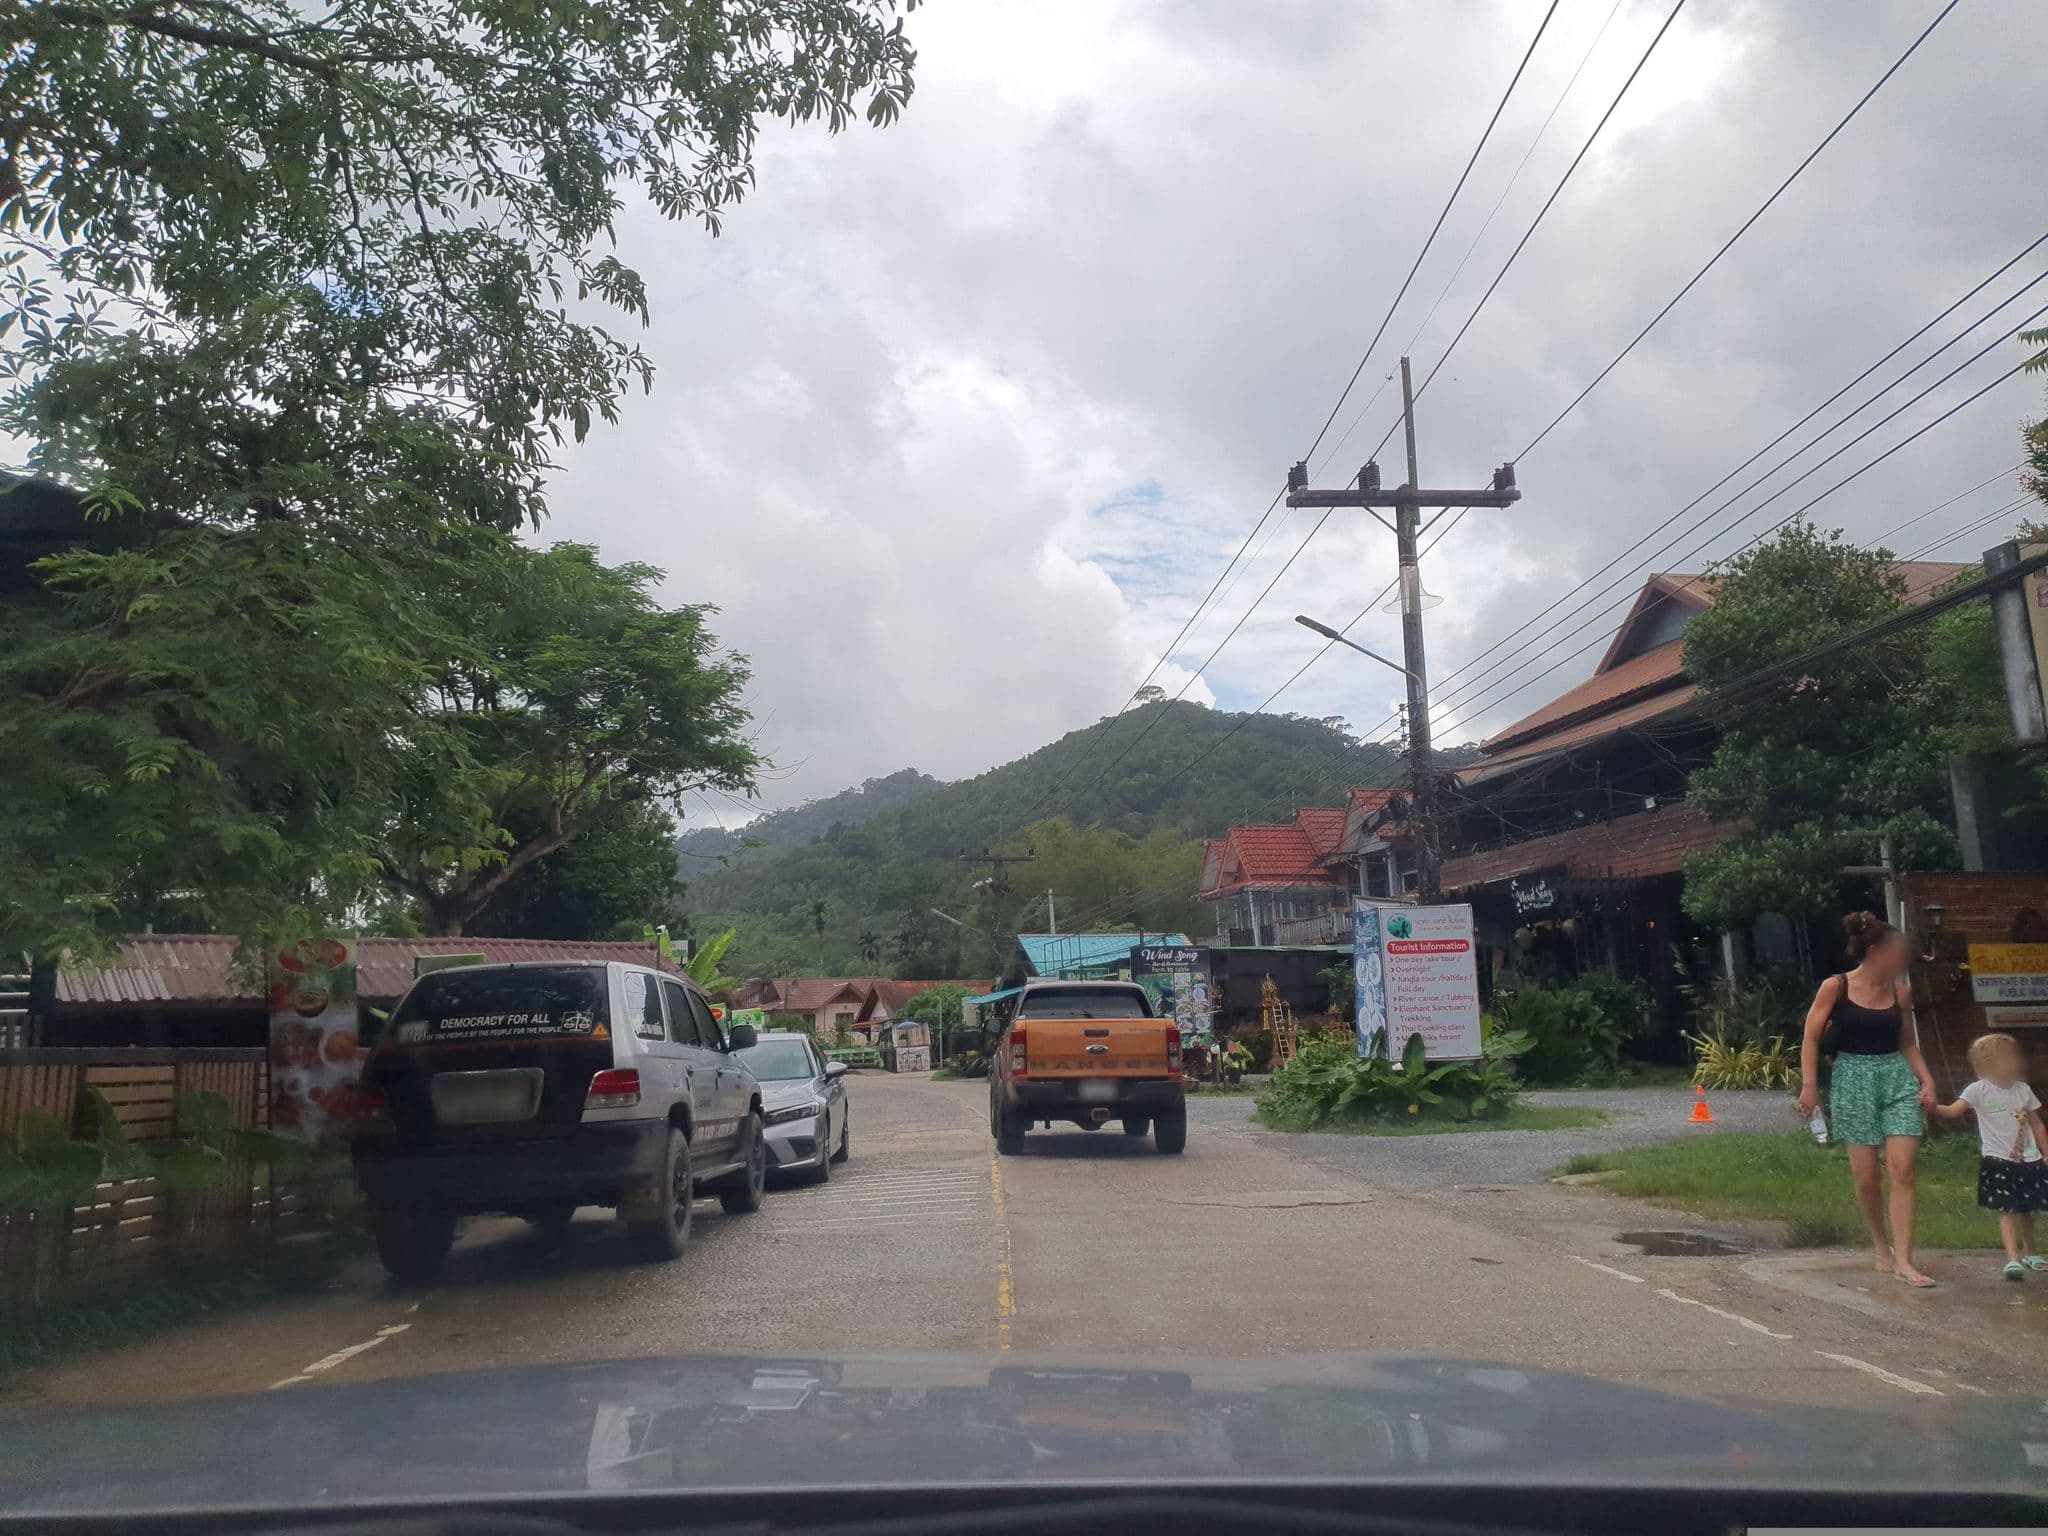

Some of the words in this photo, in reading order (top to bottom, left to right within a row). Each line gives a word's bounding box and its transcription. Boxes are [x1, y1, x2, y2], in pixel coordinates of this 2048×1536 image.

[1391, 943, 1419, 952] Tourist
[1420, 941, 1467, 951] Information
[1142, 949, 1173, 960] Wind
[1174, 950, 1198, 961] Song
[1411, 956, 1423, 964] day
[1397, 976, 1419, 984] Jungle
[1412, 985, 1425, 993] day
[1446, 993, 1474, 1002] Tubbing
[1399, 1005, 1430, 1013] Elephant
[1432, 1004, 1467, 1012] Sanctuary
[440, 1015, 505, 1029] DEMOCRACY
[507, 1014, 529, 1025] FOR
[531, 1013, 550, 1024] ALL
[446, 1031, 469, 1039] PEOPLE
[490, 1028, 512, 1036] PEOPLE
[513, 1027, 525, 1035] FOR
[538, 1026, 561, 1034] PEOPLE
[1418, 1024, 1446, 1032] Cooking
